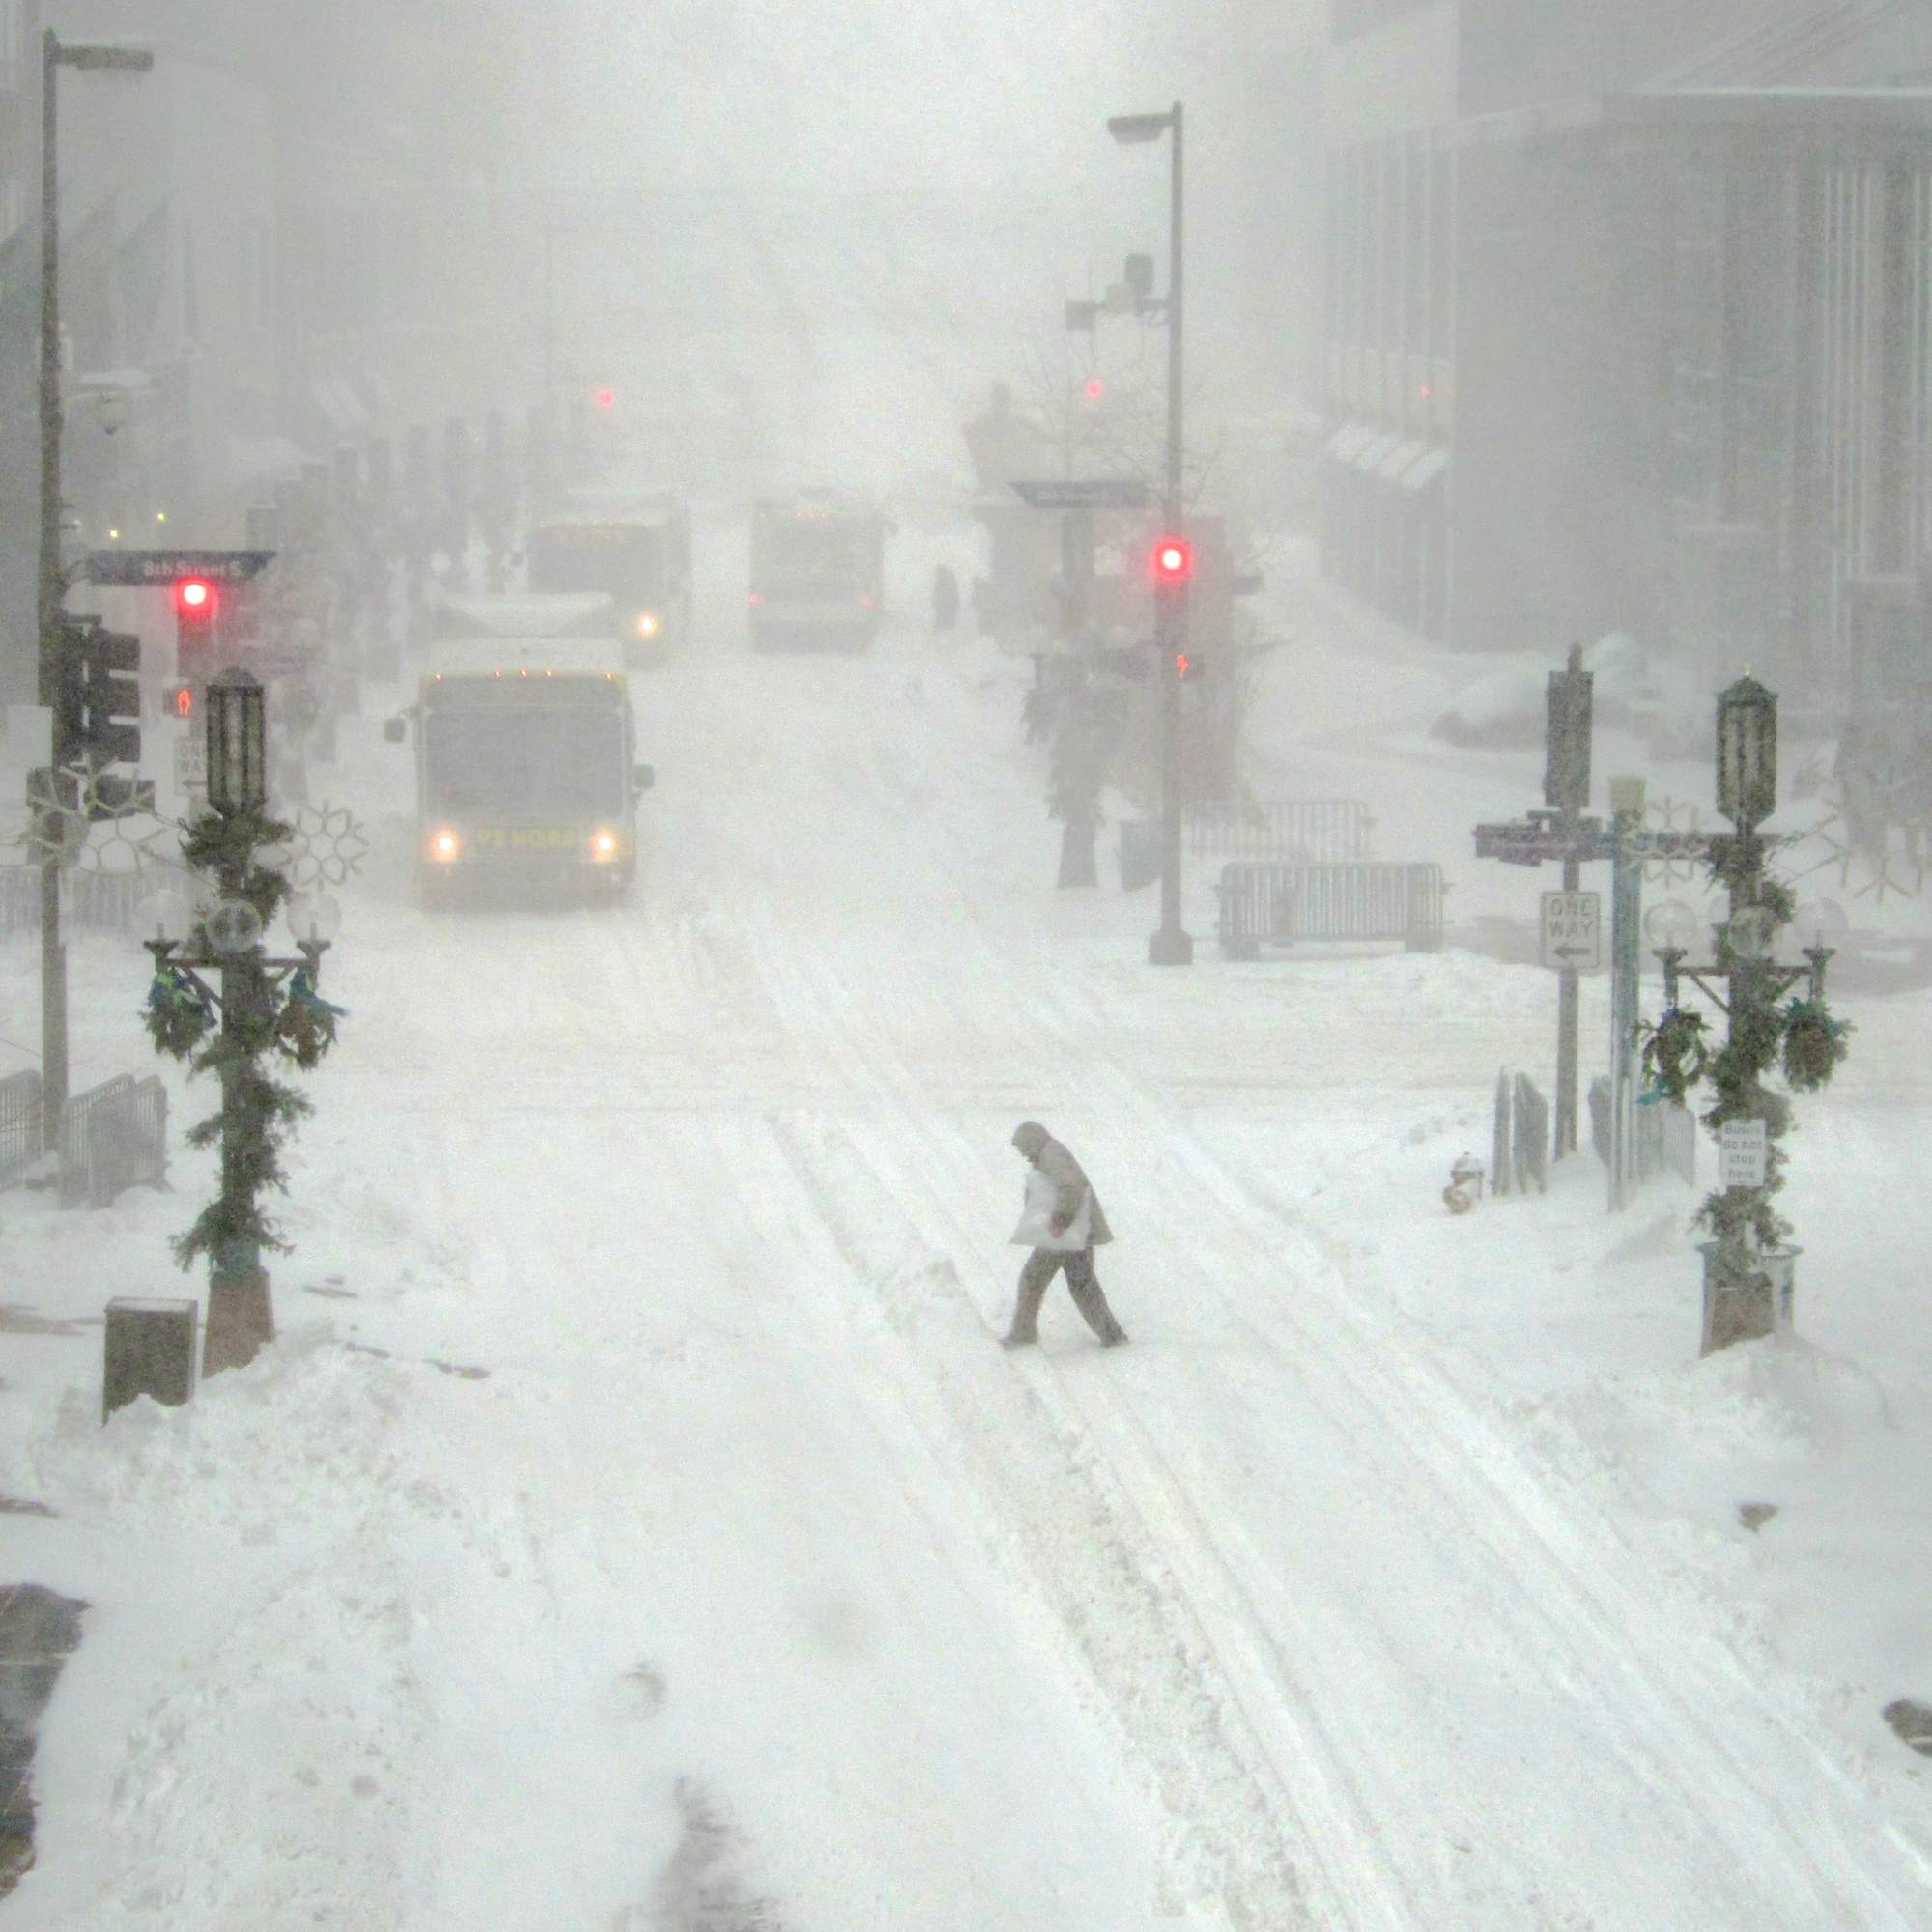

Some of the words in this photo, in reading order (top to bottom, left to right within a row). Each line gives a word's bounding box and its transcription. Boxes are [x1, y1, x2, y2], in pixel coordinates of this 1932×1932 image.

[143, 559, 173, 577] 8th
[176, 559, 227, 577] Street
[179, 743, 204, 757] ON
[179, 760, 204, 774] WA
[1551, 896, 1592, 917] ONE
[1550, 920, 1593, 938] WAY
[1722, 1141, 1738, 1150] do
[1742, 1141, 1763, 1150] not
[1728, 1154, 1755, 1165] stop
[1728, 1168, 1756, 1179] here
